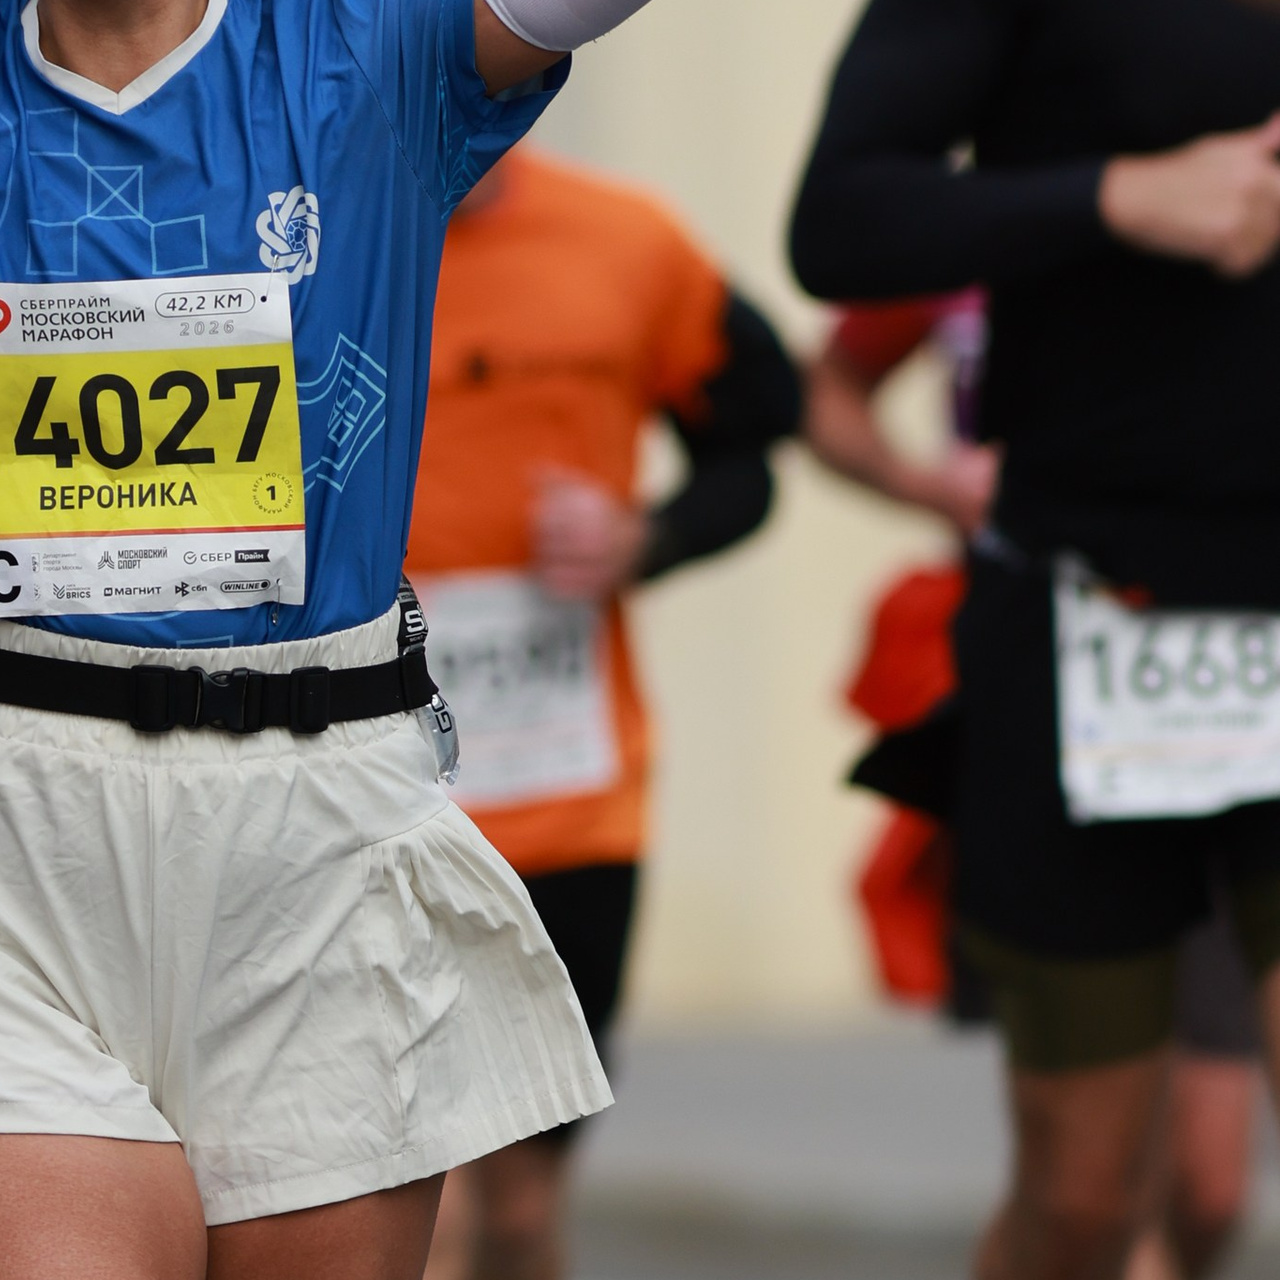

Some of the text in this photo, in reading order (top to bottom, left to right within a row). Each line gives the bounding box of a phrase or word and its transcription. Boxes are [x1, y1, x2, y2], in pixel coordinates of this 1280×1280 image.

[20, 296, 111, 310] СБЕРПРАЙМ
[166, 294, 243, 313] 42,2 КМ
[21, 306, 146, 326] МОСКОВСКИЙ
[22, 326, 114, 343] МАРАФОН
[179, 320, 235, 337] 2026
[39, 481, 198, 511] ВЕРОНИКА
[266, 485, 276, 501] 1
[117, 547, 168, 559] МОСКОВСКИЙ
[200, 552, 232, 562] СБЕР
[237, 551, 264, 561] Прайм
[117, 560, 141, 570] СПОРТ
[223, 582, 260, 591] WINLINE
[66, 591, 91, 599] BRICS
